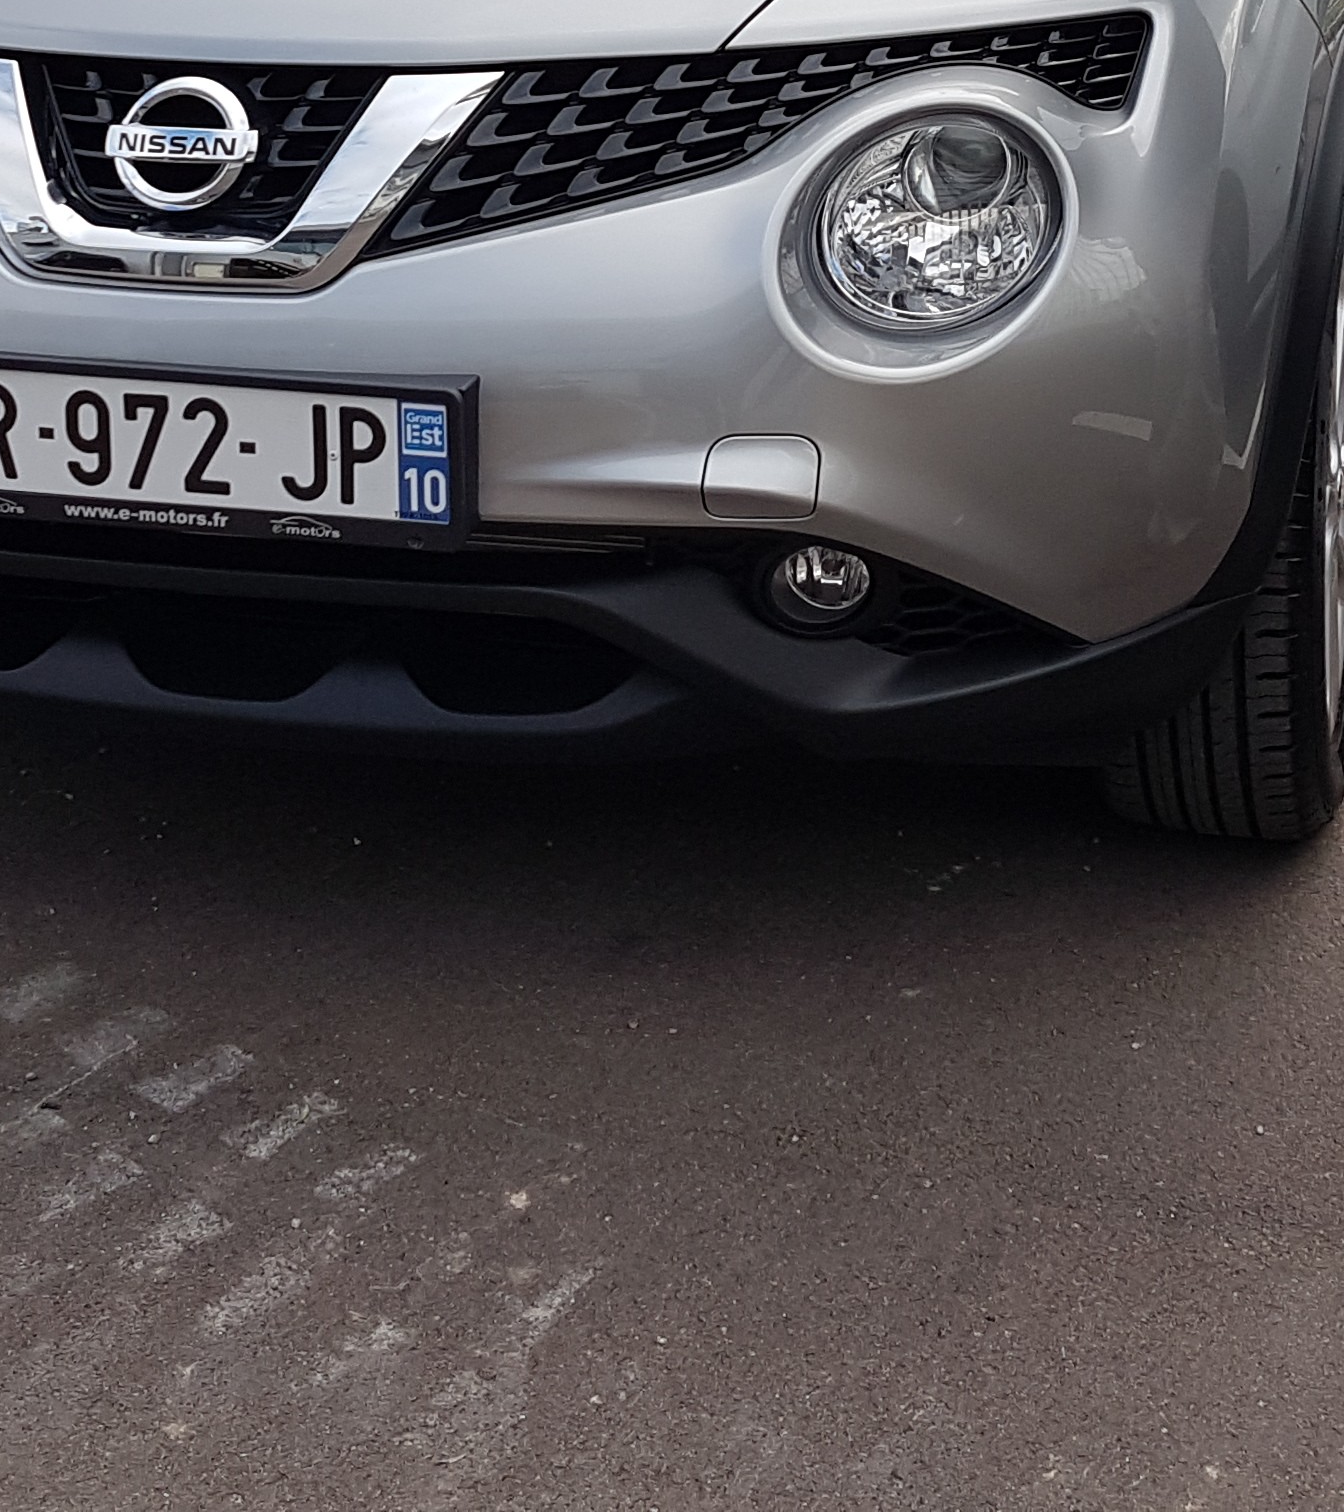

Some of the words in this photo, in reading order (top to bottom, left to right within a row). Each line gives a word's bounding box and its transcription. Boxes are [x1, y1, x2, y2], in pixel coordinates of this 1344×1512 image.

[118, 132, 238, 156] NISSAN
[405, 411, 444, 426] Grand
[406, 423, 444, 447] Est
[403, 466, 448, 514] 10
[63, 494, 230, 518] www.e-motors.fr
